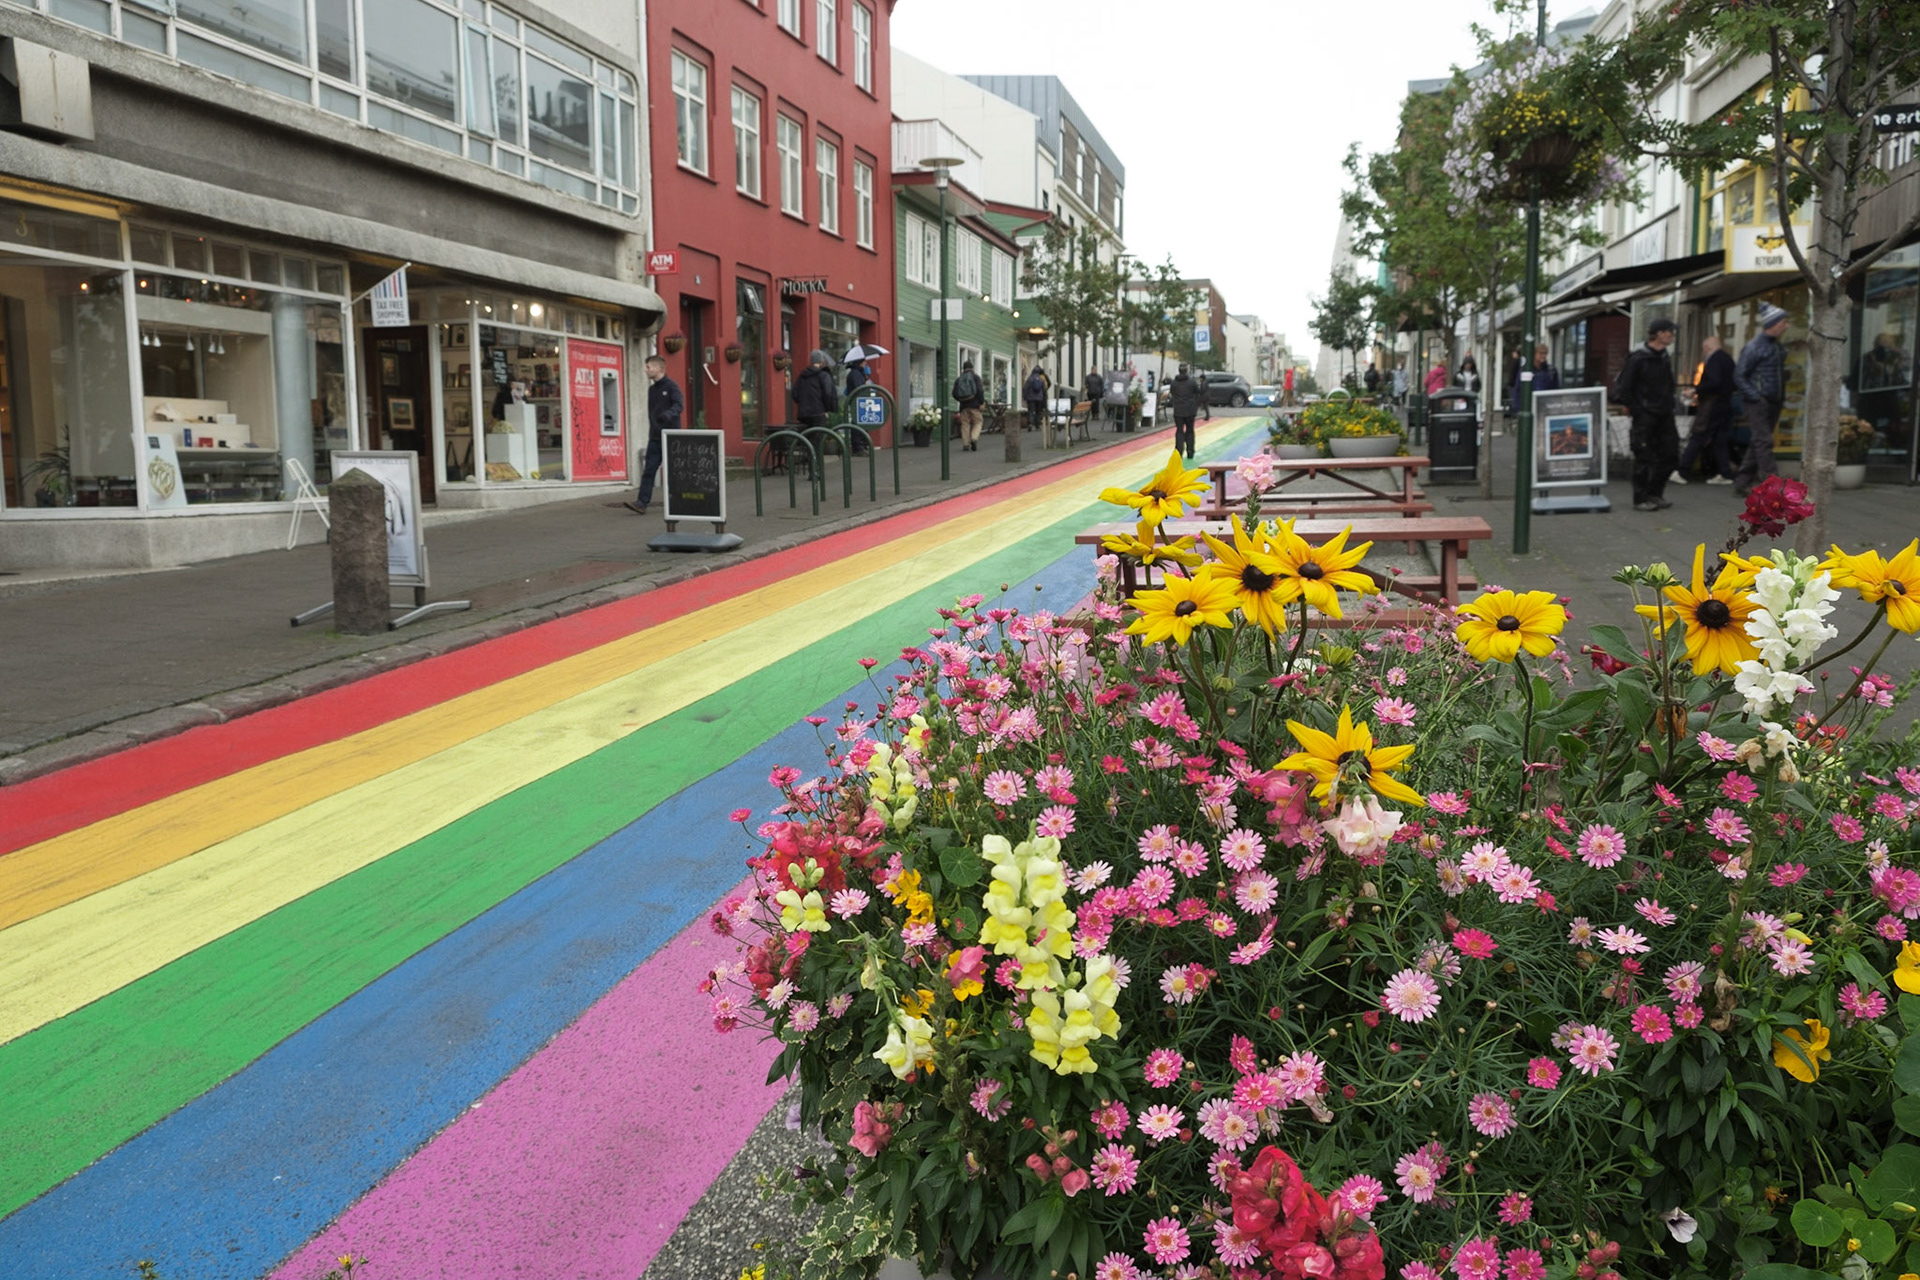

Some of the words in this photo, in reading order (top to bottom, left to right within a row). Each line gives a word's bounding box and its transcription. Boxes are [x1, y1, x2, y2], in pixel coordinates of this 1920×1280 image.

[650, 254, 674, 266] ATM
[783, 279, 826, 296] MOKKA
[376, 300, 388, 310] TAX
[389, 300, 405, 310] FREE
[376, 310, 406, 319] SHOPPING
[575, 367, 595, 386] ATM
